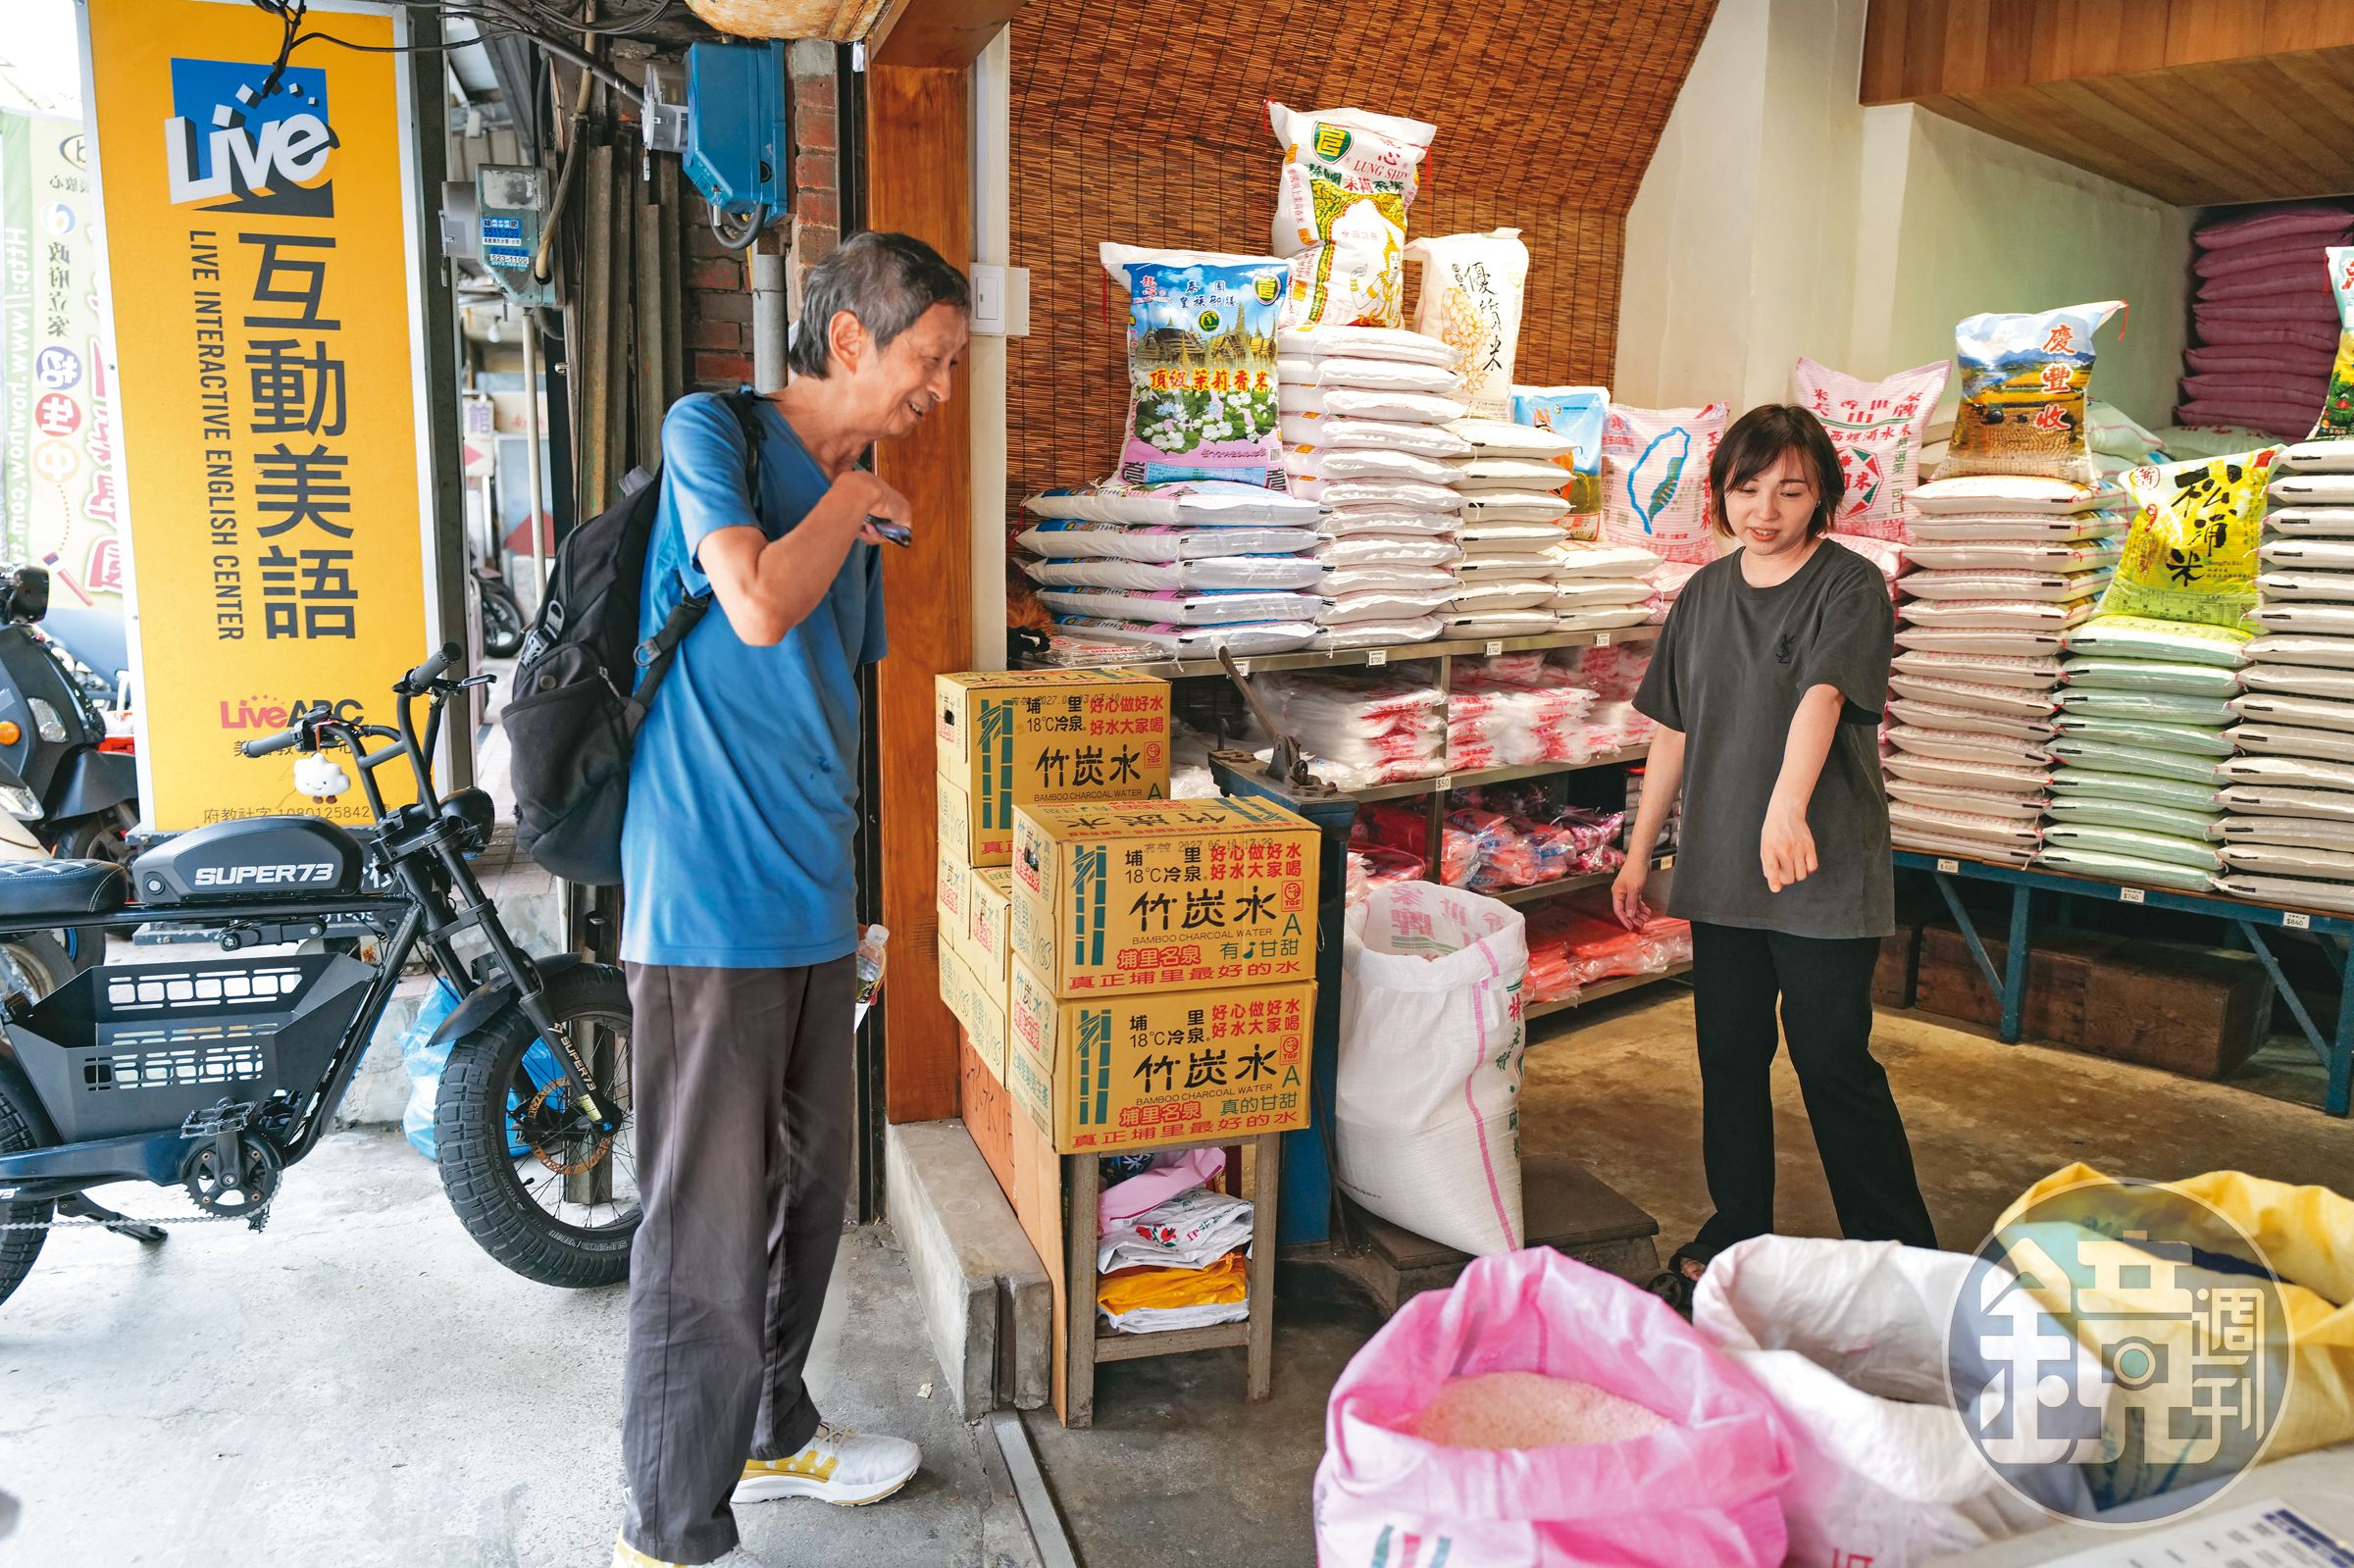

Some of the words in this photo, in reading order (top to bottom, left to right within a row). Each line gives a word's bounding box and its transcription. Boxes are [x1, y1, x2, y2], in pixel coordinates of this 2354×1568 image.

[165, 103, 332, 204] Live
[1354, 160, 1384, 177] LUNG
[189, 230, 221, 281] LIVE
[194, 291, 231, 440] INTERACTIVE
[1149, 368, 1271, 392] 頂級茉莉香米
[238, 232, 358, 640] 互動美語
[206, 454, 238, 545] ENGLISH
[2166, 464, 2242, 587] 松浦米
[213, 554, 245, 641] CENTER
[1090, 695, 1164, 714] 好心做好水
[1090, 717, 1164, 735] 好水大家喝
[1035, 744, 1141, 787] 竹炭水
[1148, 783, 1162, 800] A
[1437, 778, 1450, 788] $50
[1034, 793, 1069, 802] BAMBOO
[1069, 790, 1112, 800] CHARCOAL
[1113, 788, 1143, 797] WATER
[1125, 846, 1202, 868] 埔里
[1210, 842, 1303, 863] 好心做好水
[194, 863, 334, 885] SUPER73
[1210, 860, 1302, 881] 好水大家喝
[2124, 892, 2139, 901] $740
[1129, 885, 1277, 932] 竹炭水
[1282, 913, 1303, 936] A
[2286, 918, 2304, 927] $840
[1132, 935, 1177, 945] BAMBOO
[1178, 931, 1234, 941] CHARCOAL
[1236, 928, 1273, 938] WATER
[1116, 943, 1203, 971] 埔里名泉
[1069, 960, 1302, 990] 真正埔里最好的水
[1130, 1009, 1204, 1031] 埔里
[1211, 998, 1301, 1022] 好心做好水
[1211, 1015, 1300, 1038] 好水大家喝
[560, 1036, 597, 1091] SUPER73
[1133, 1043, 1277, 1093] 竹炭水
[1282, 1065, 1301, 1088] A
[1136, 1093, 1180, 1106] BAMBOO
[1181, 1087, 1236, 1101] CHARCOAL
[1238, 1083, 1273, 1095] WATER
[1220, 1091, 1299, 1116] 真的甘甜
[1119, 1100, 1203, 1129] 埔里名泉
[1071, 1111, 1299, 1149] 真正埔里最好的水
